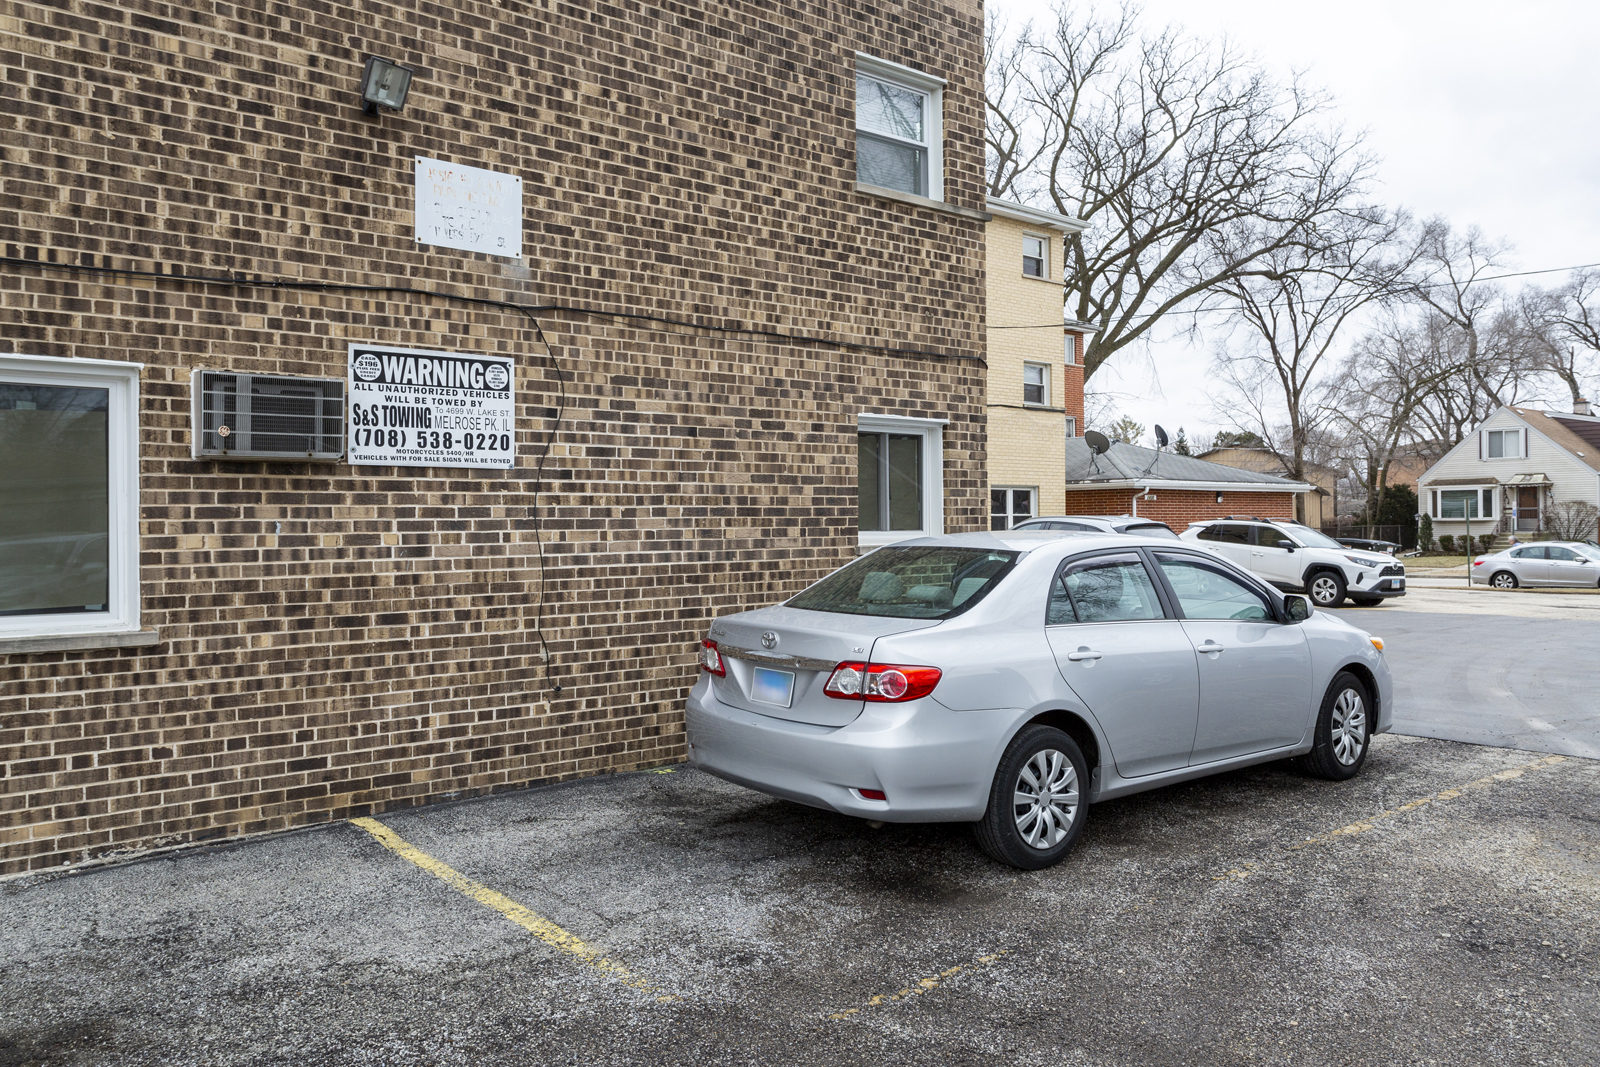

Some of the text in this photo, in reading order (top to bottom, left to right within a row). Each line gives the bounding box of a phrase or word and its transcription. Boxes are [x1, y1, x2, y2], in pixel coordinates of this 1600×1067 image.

[382, 355, 484, 390] WARNING
[354, 383, 510, 399] ALL UNAUTHORIZED VEHICLES
[384, 395, 410, 403] WILL
[432, 398, 466, 407] TOWED
[353, 403, 432, 429] S&S TOWING
[446, 407, 464, 415] 4699
[477, 409, 497, 417] LAKE
[434, 415, 510, 432] MELROSE PK. IL
[354, 428, 510, 451] (708) 538-0220
